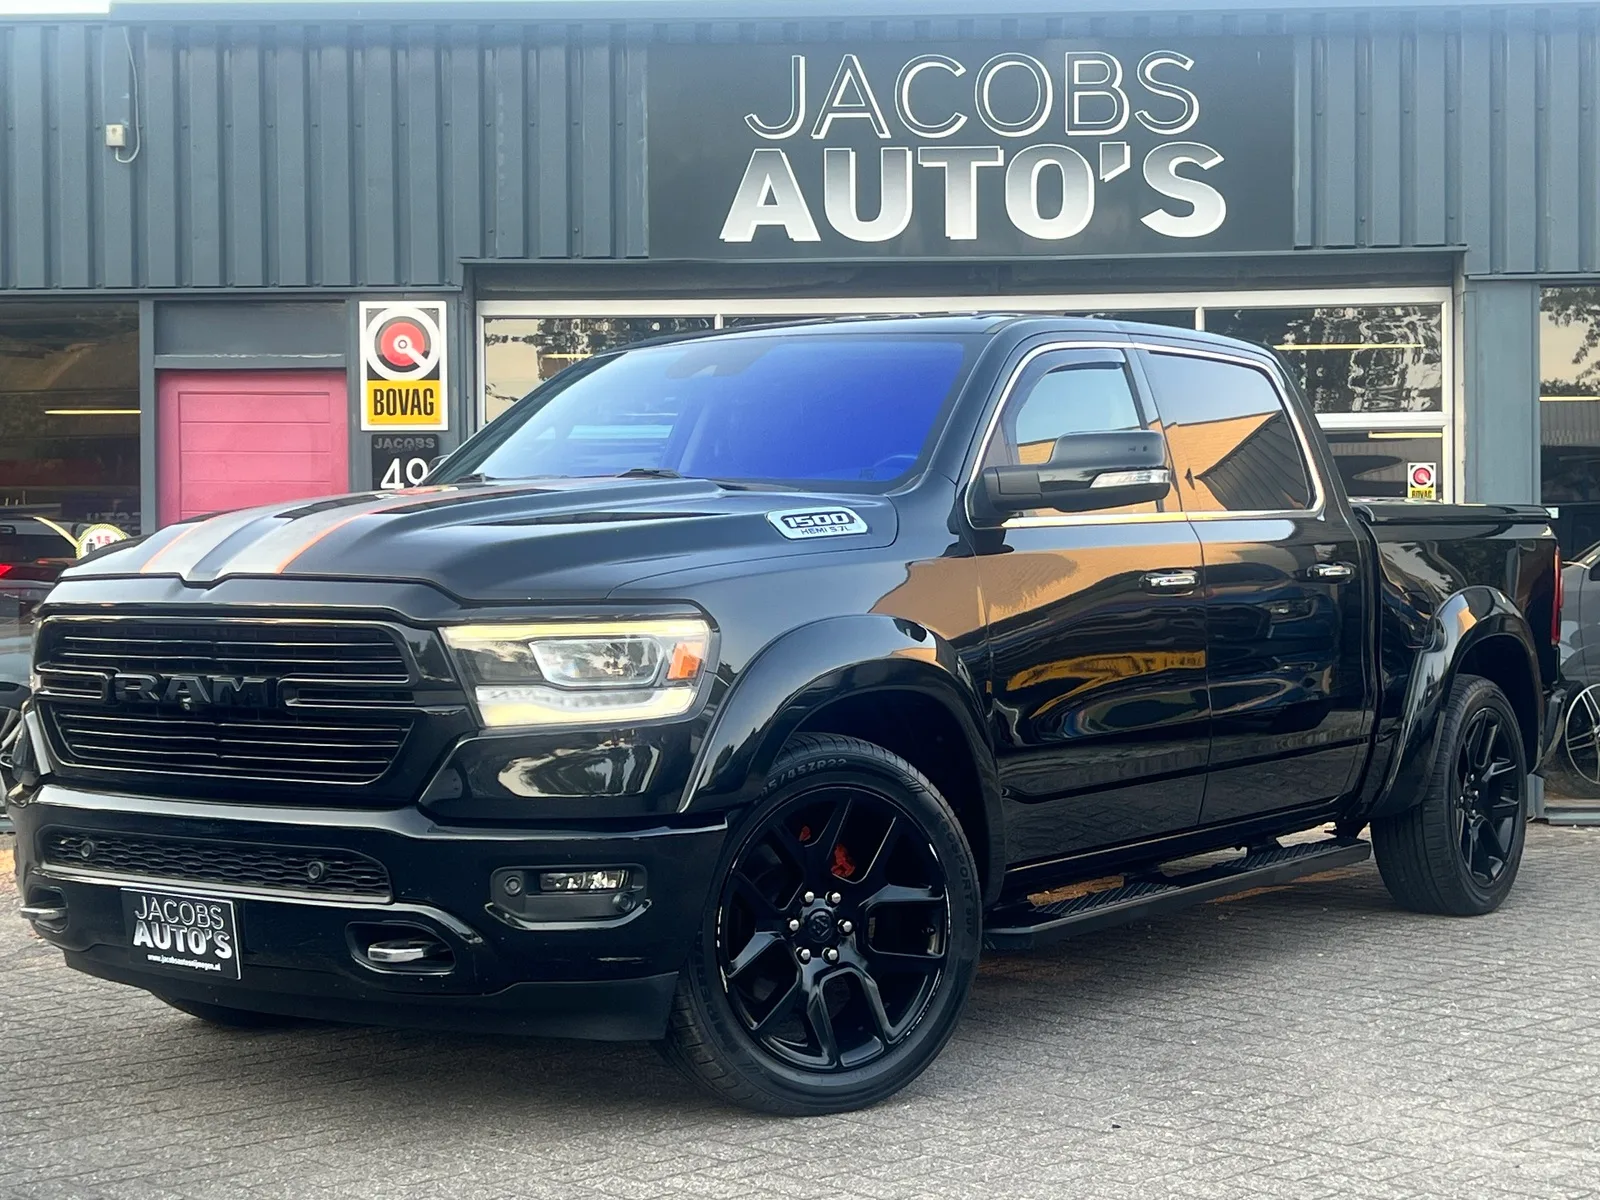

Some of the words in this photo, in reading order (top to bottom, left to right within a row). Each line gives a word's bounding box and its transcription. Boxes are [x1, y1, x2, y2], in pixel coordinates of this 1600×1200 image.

[744, 49, 1200, 139] JACOBS
[719, 141, 1227, 243] AUTO'S
[374, 388, 434, 416] BOVAG
[374, 438, 435, 449] JACOBS
[783, 513, 850, 527] 1500
[114, 672, 268, 707] RAM
[134, 895, 225, 930] JACOBS
[133, 920, 233, 959] AUTO'S
